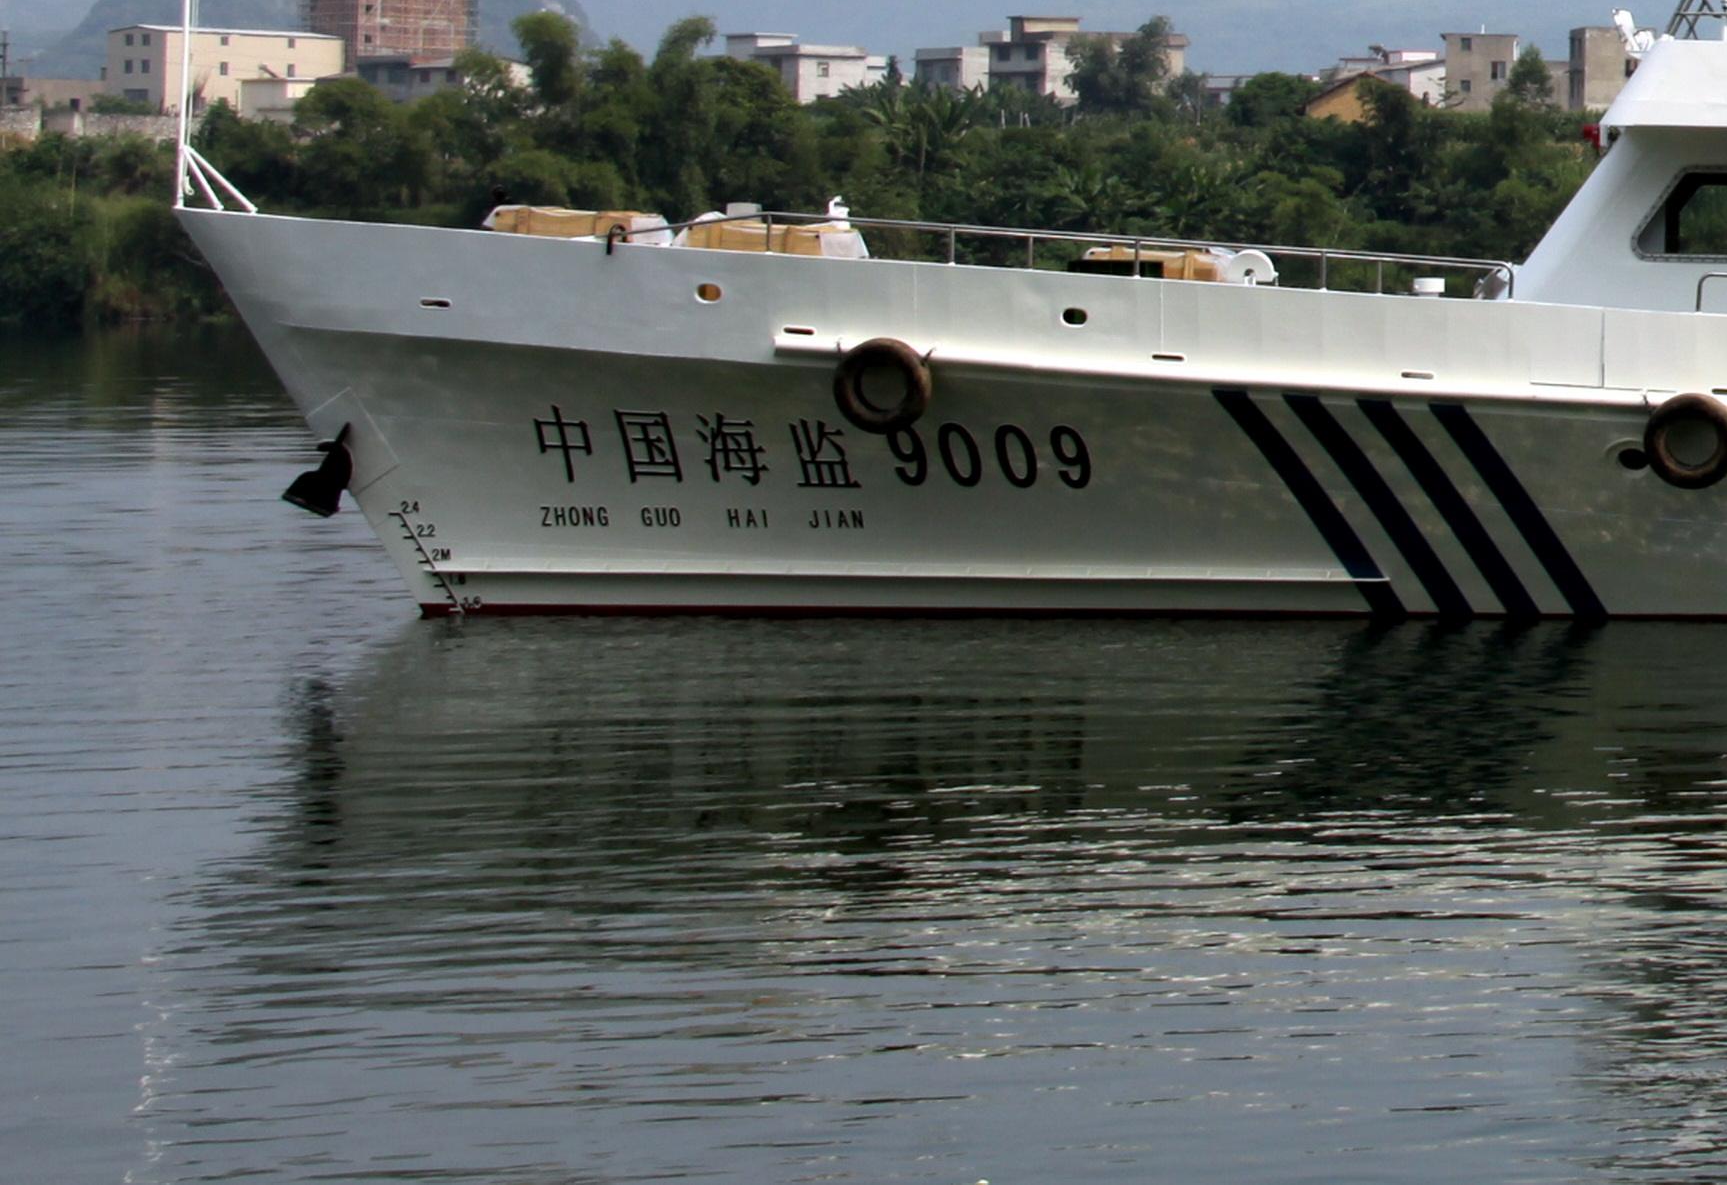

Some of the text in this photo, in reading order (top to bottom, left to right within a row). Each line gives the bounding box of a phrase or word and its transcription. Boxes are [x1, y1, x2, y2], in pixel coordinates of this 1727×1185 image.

[539, 505, 864, 530] ZHONG GUO HAI JIAN
